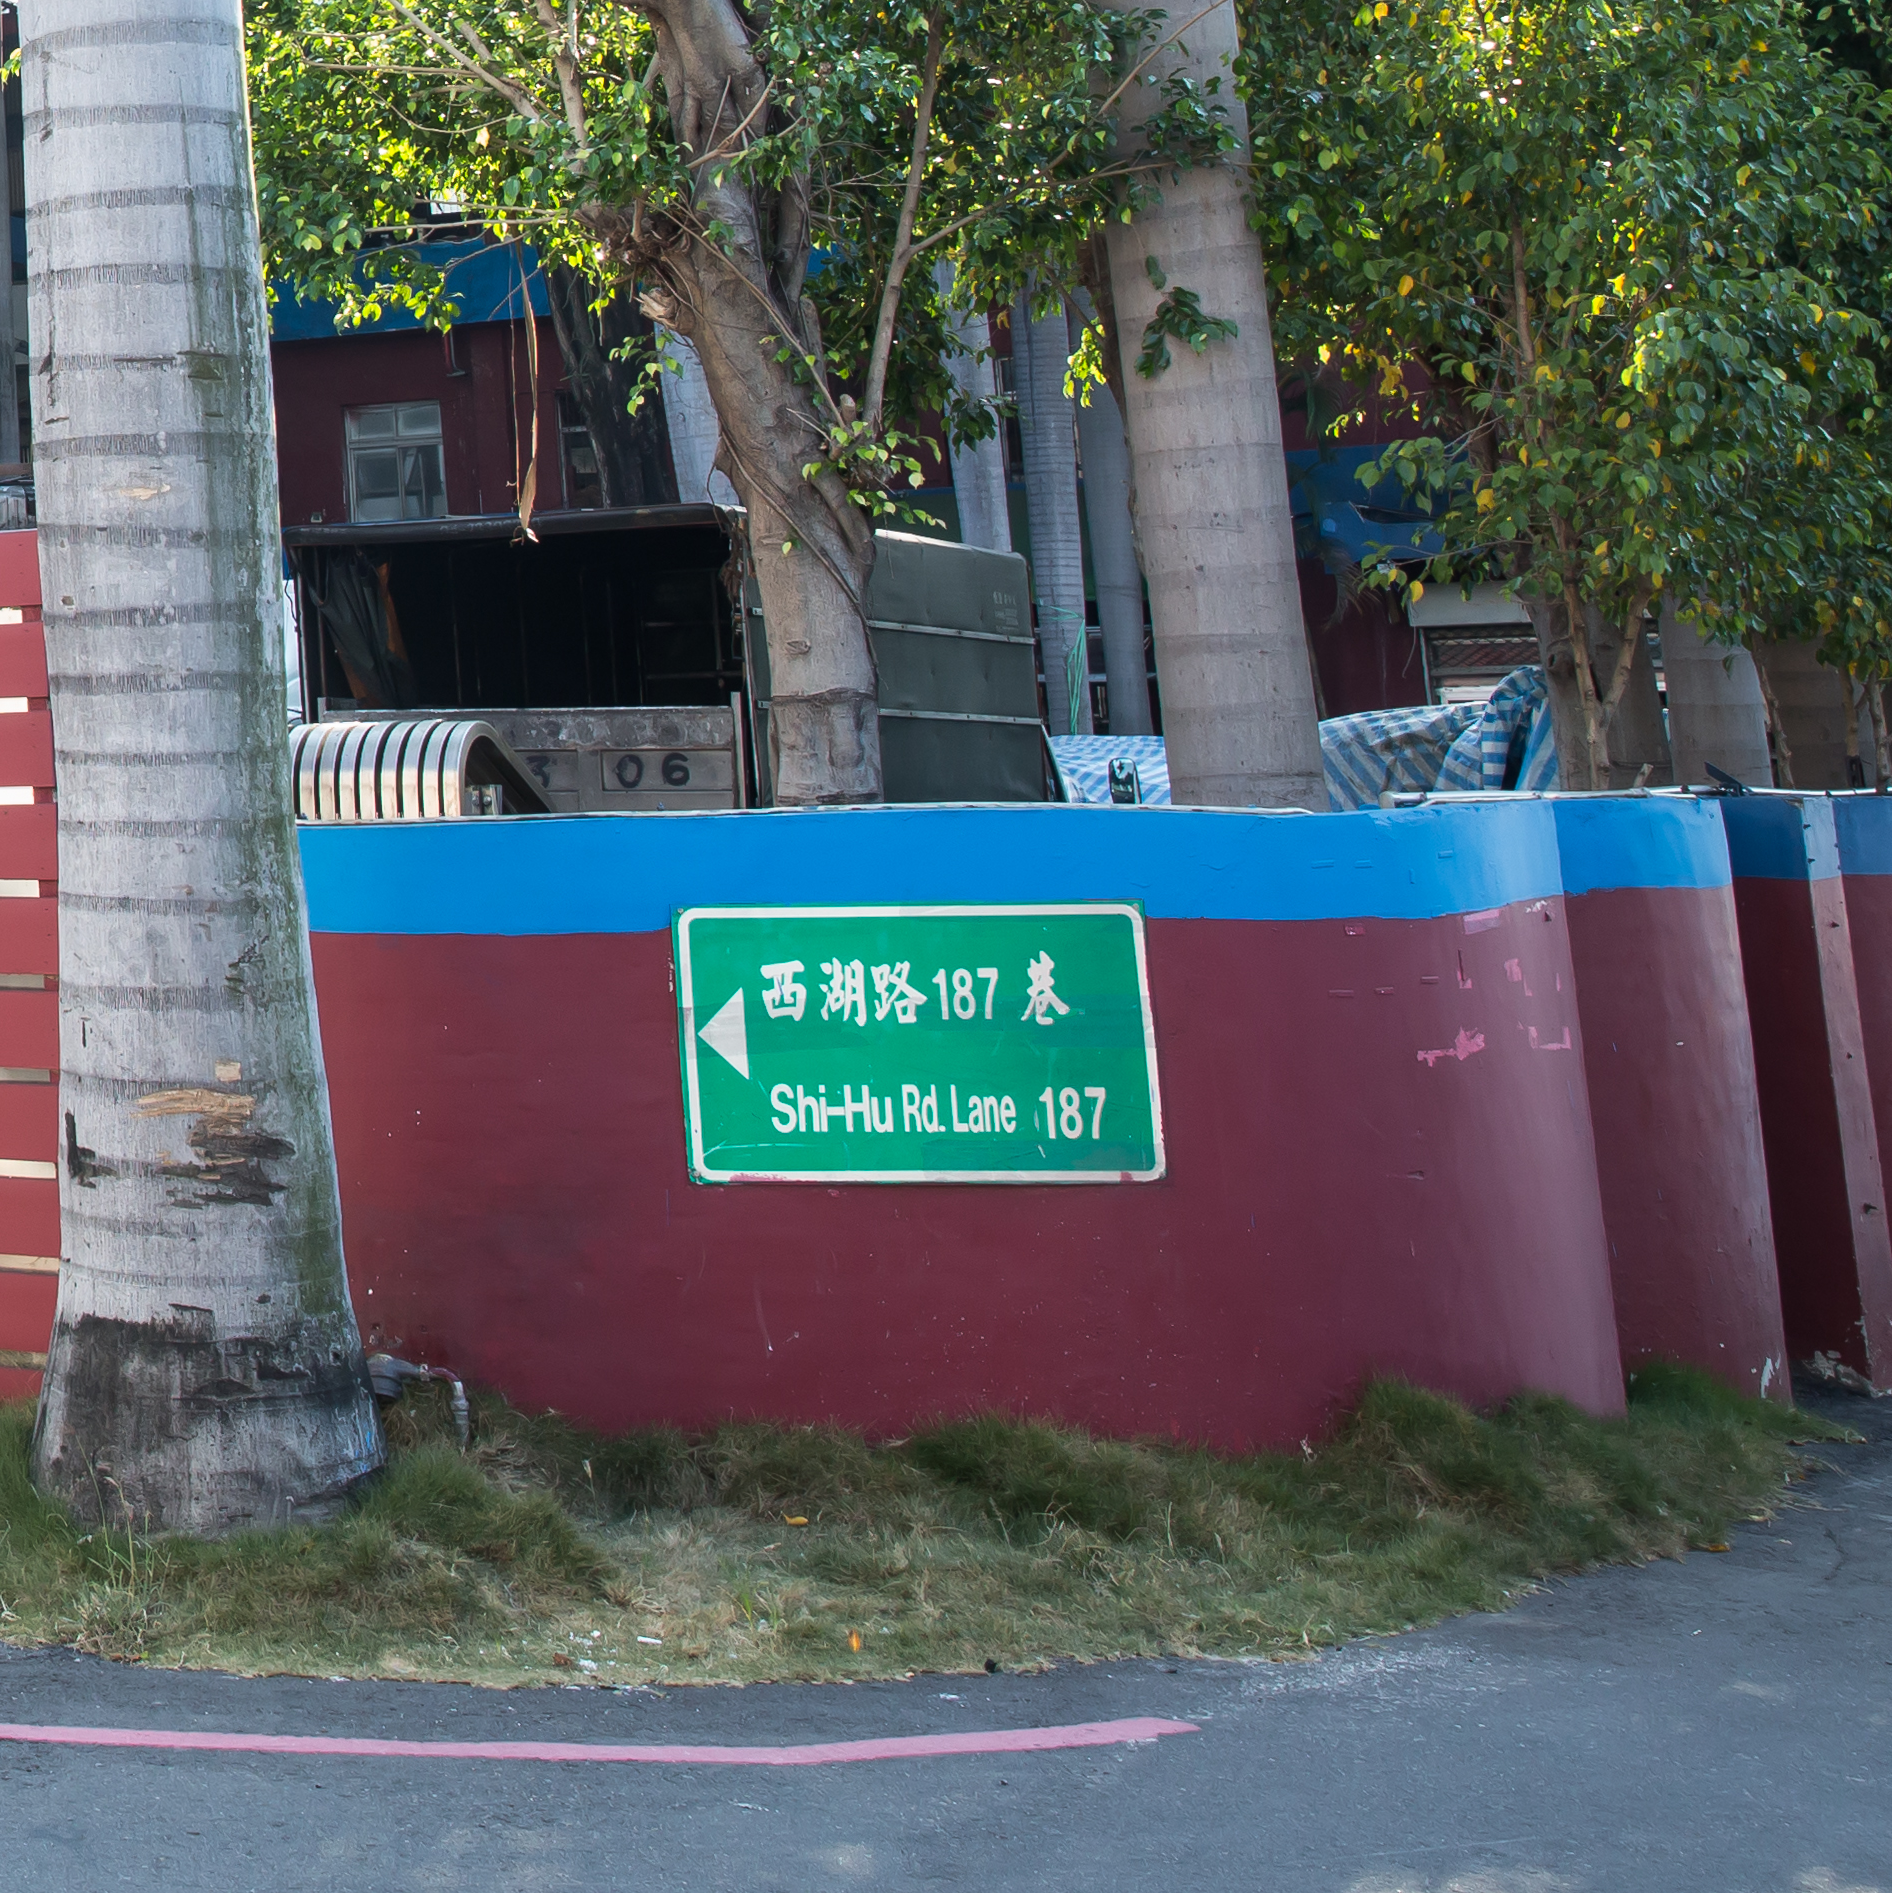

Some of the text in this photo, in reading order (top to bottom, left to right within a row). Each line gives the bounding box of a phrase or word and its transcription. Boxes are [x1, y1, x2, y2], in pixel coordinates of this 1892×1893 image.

[770, 1083, 1106, 1139] Shi-Hu Rd. Lane 187
